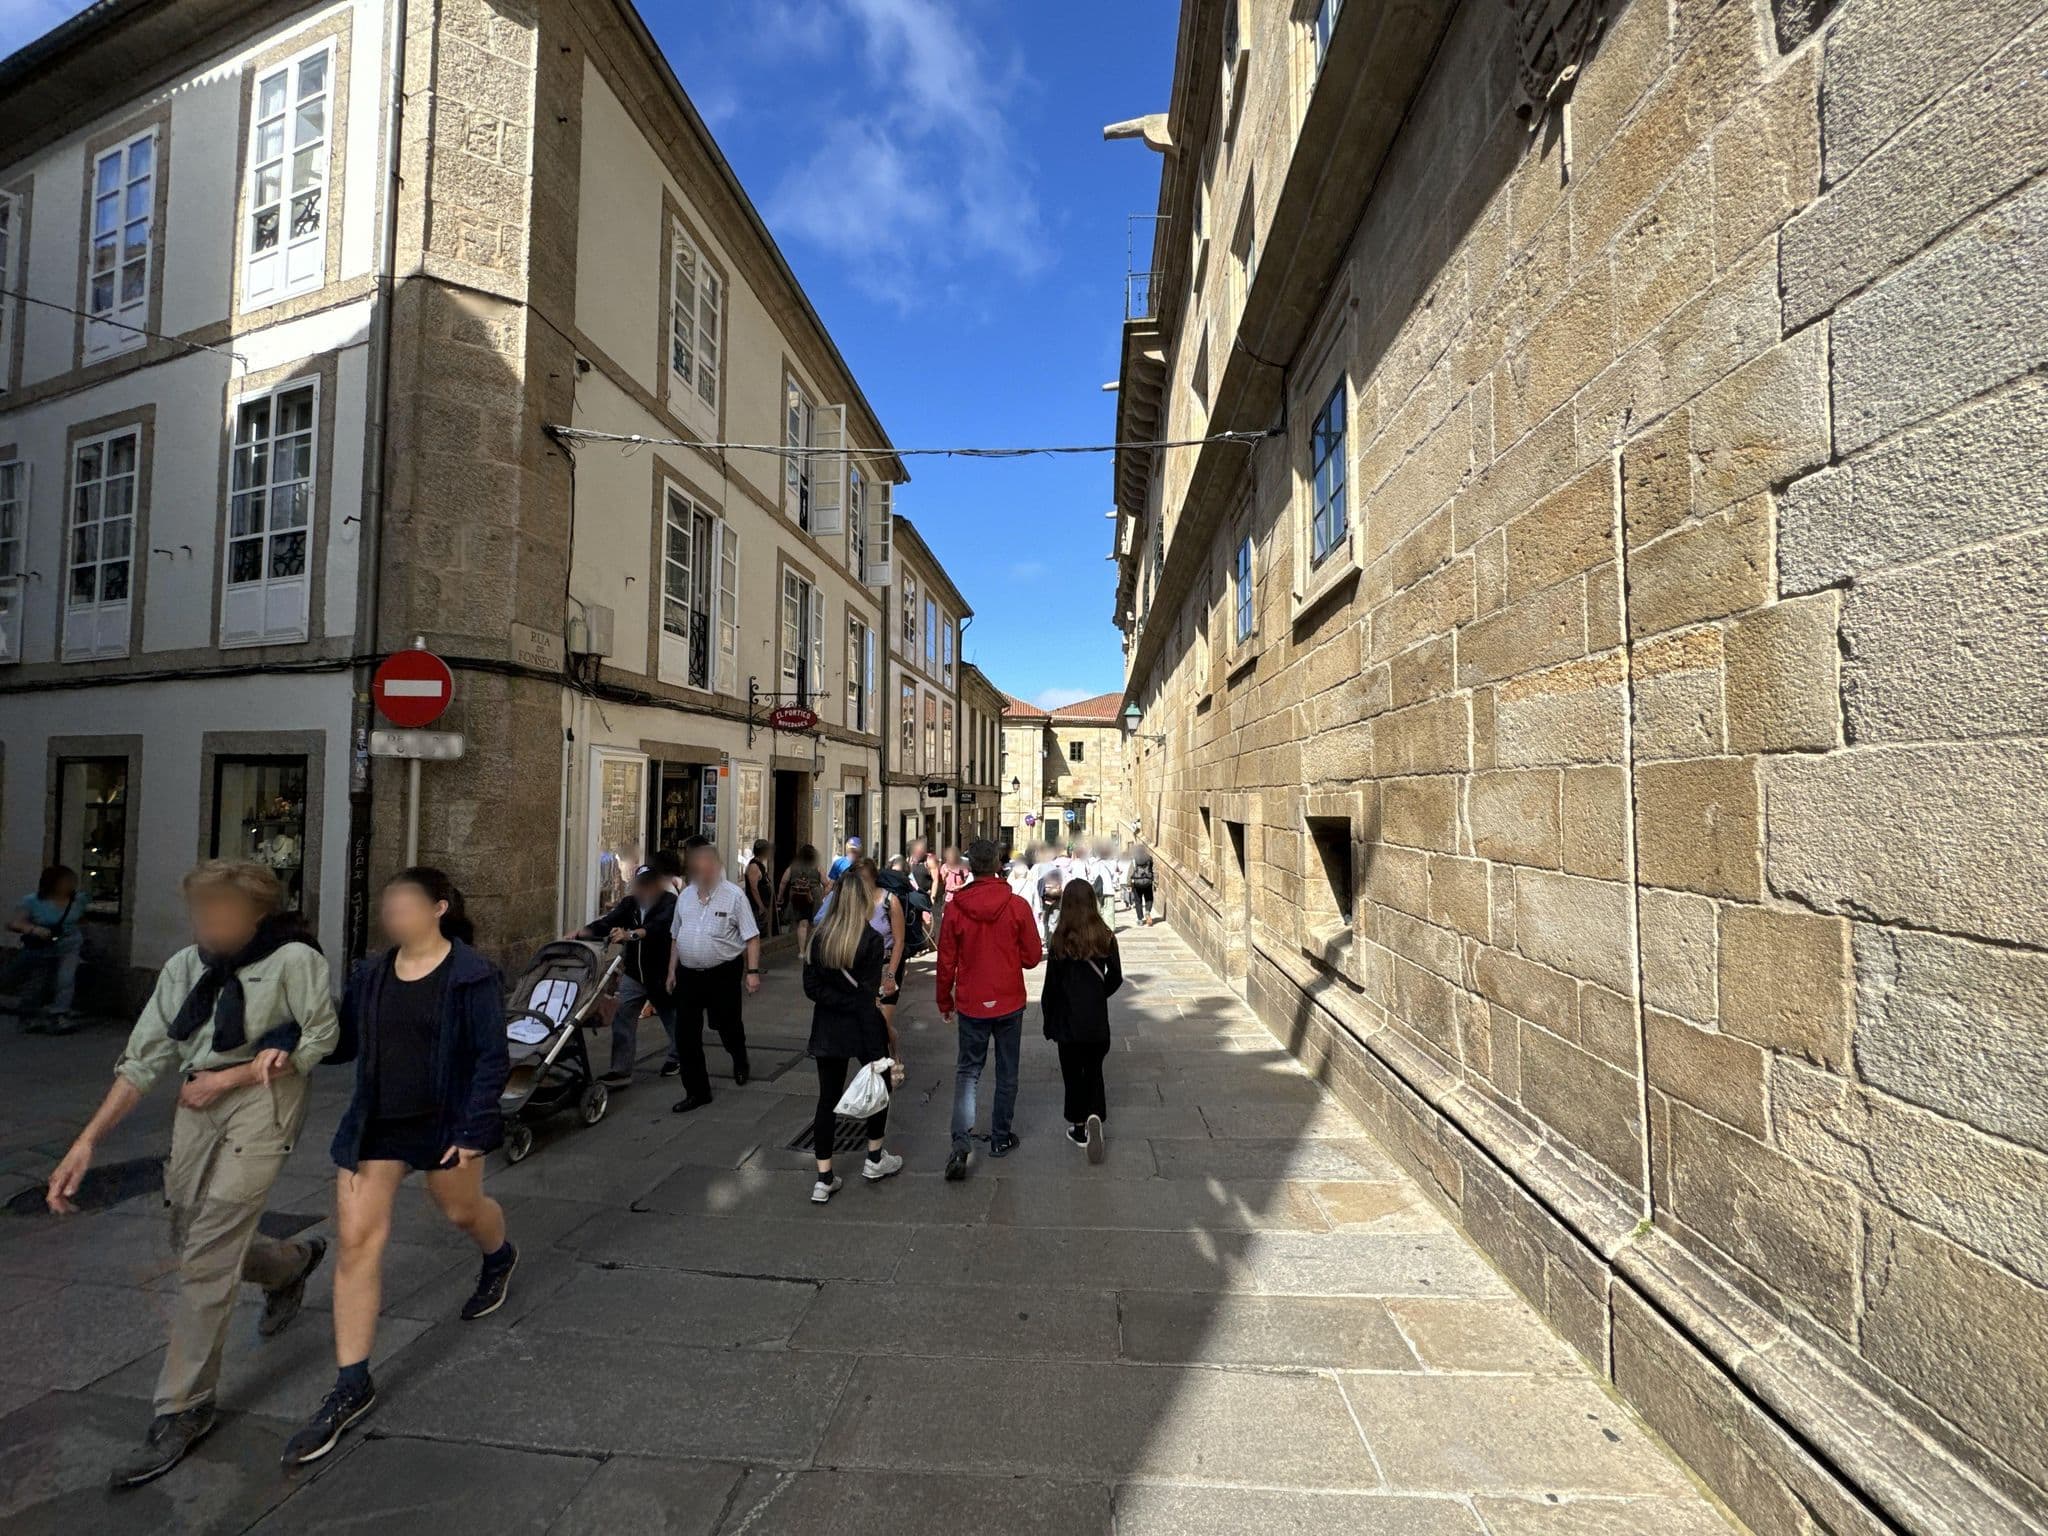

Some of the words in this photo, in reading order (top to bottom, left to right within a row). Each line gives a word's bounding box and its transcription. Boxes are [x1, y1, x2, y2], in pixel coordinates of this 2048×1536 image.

[531, 631, 550, 647] RUA
[518, 649, 559, 670] FONSECA
[776, 711, 784, 719] EL
